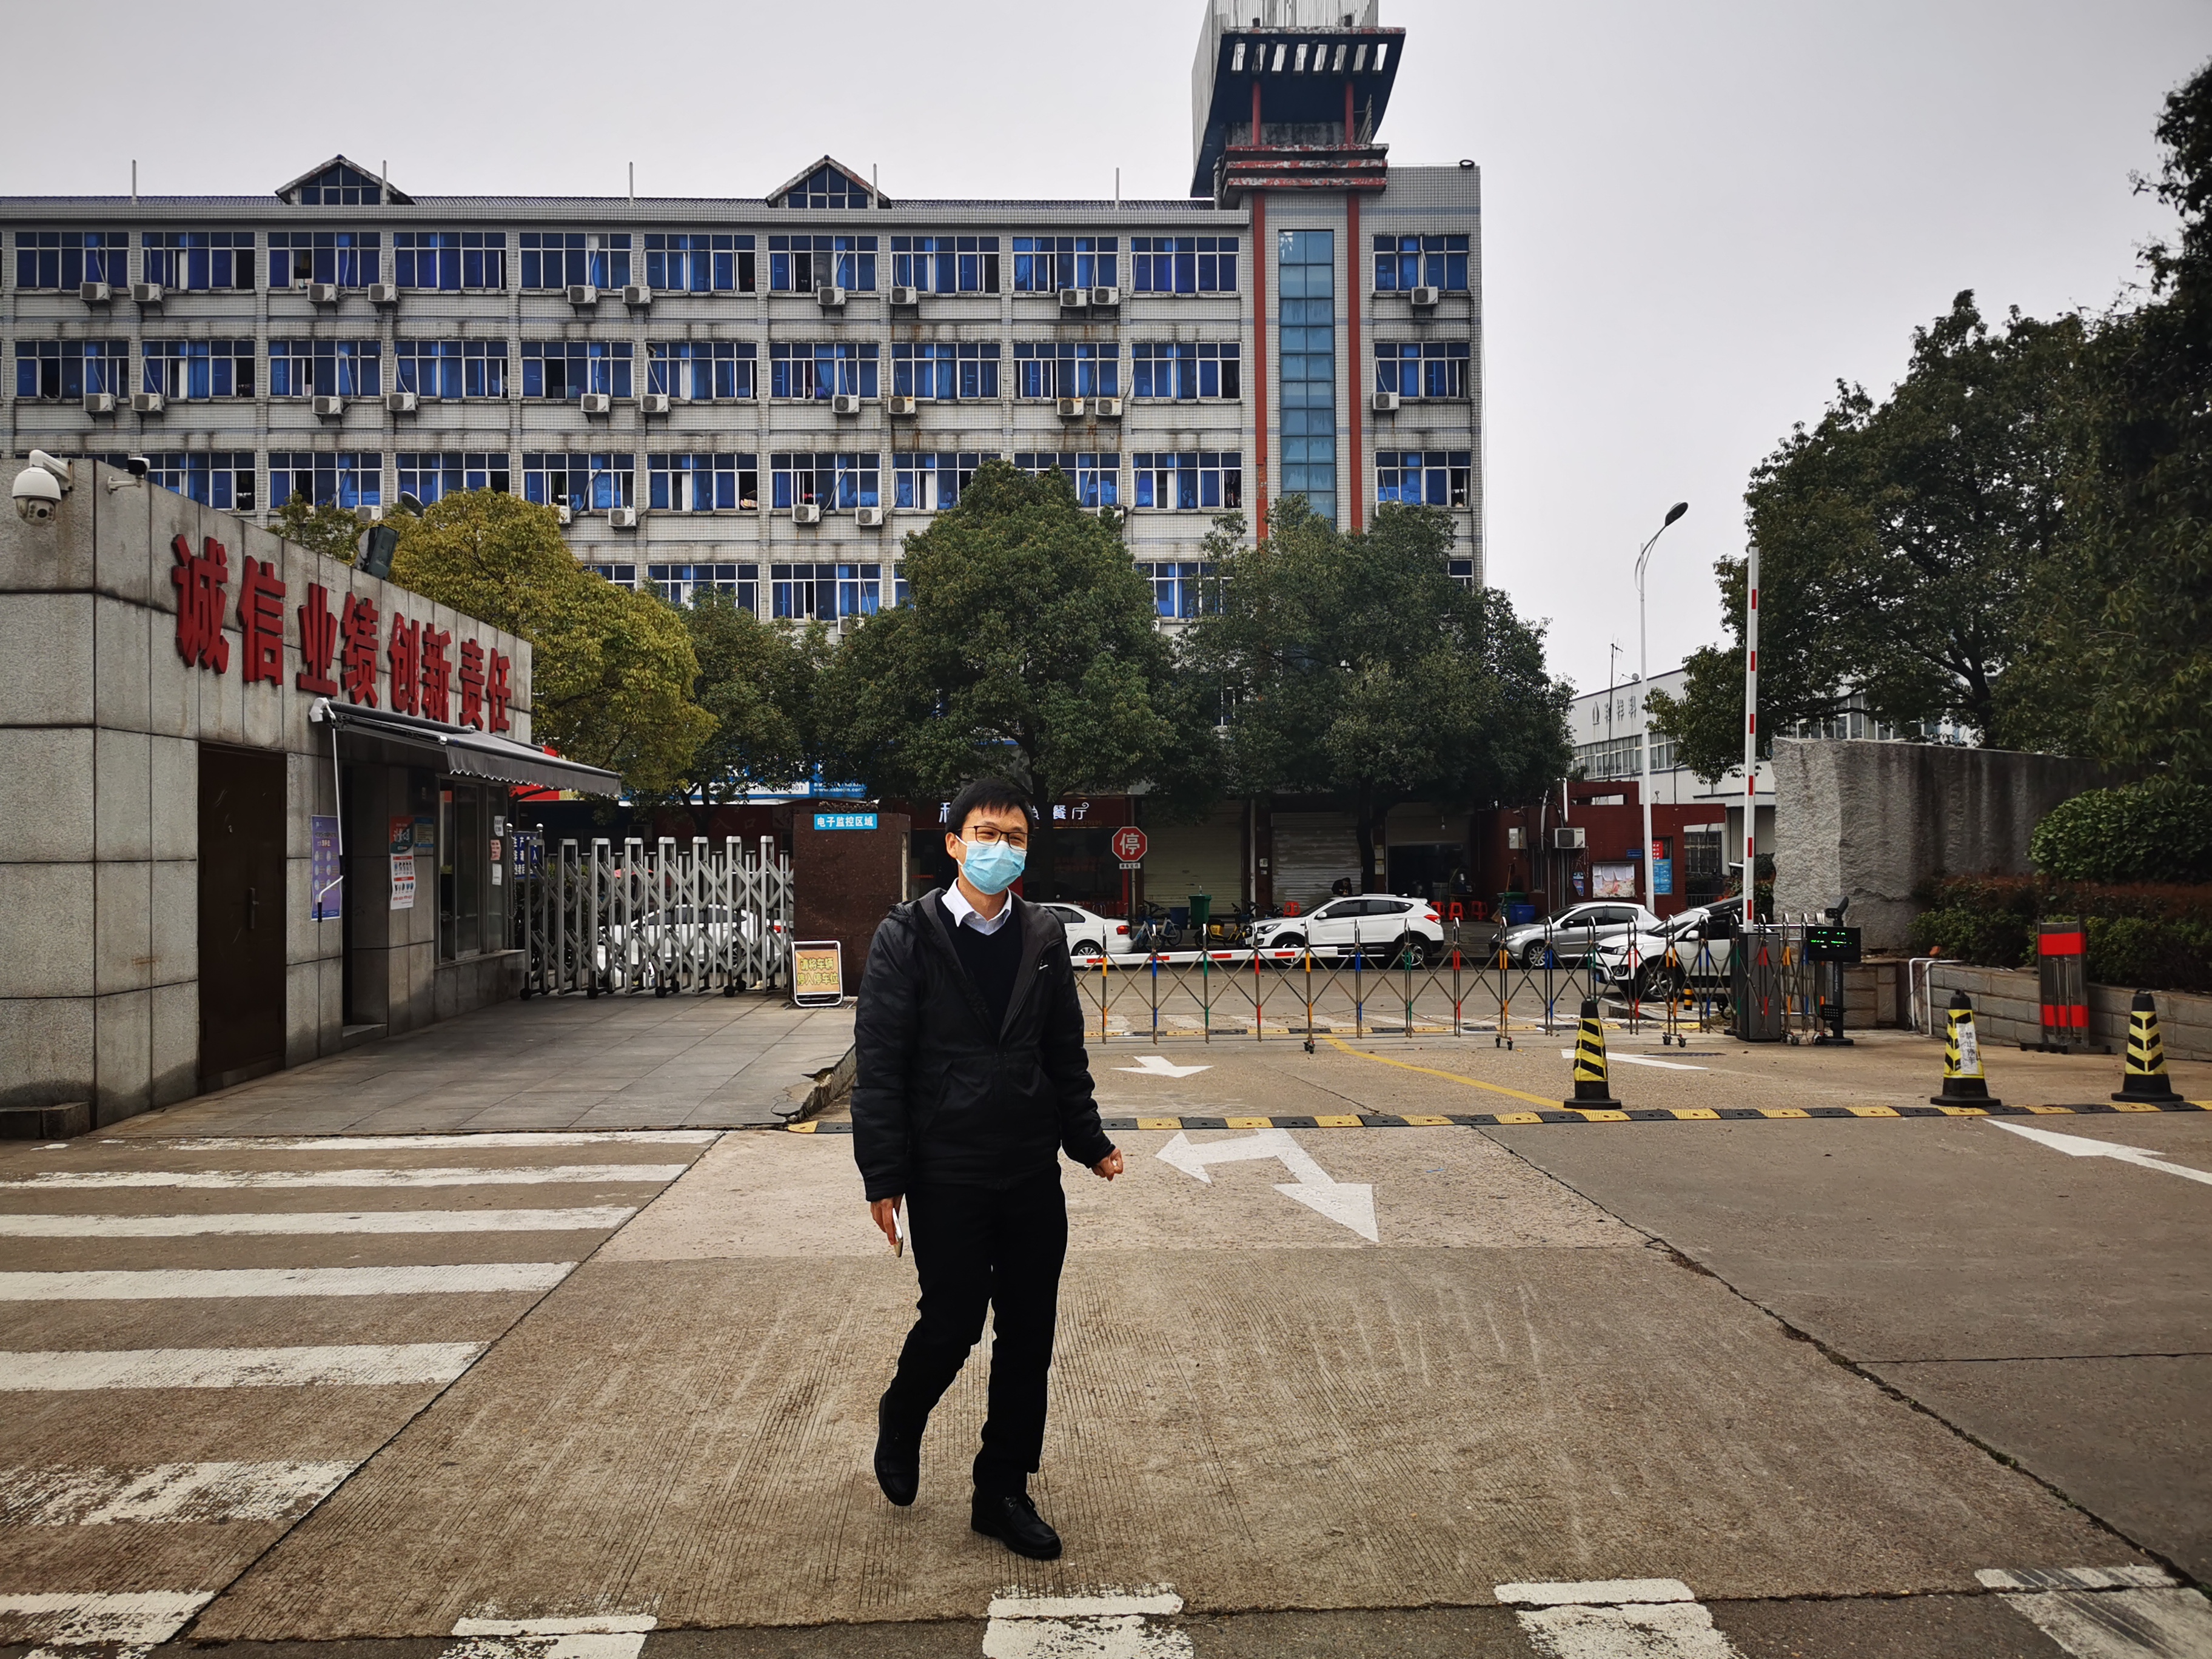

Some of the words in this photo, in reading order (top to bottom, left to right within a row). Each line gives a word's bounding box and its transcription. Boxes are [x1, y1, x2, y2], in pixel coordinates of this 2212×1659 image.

[817, 816, 874, 828] 电子监控区域
[1119, 833, 1140, 856] 停
[800, 957, 834, 971] 请将车辆
[797, 971, 839, 986] 停入停车位
[1965, 1031, 1976, 1065] 禁止停车
